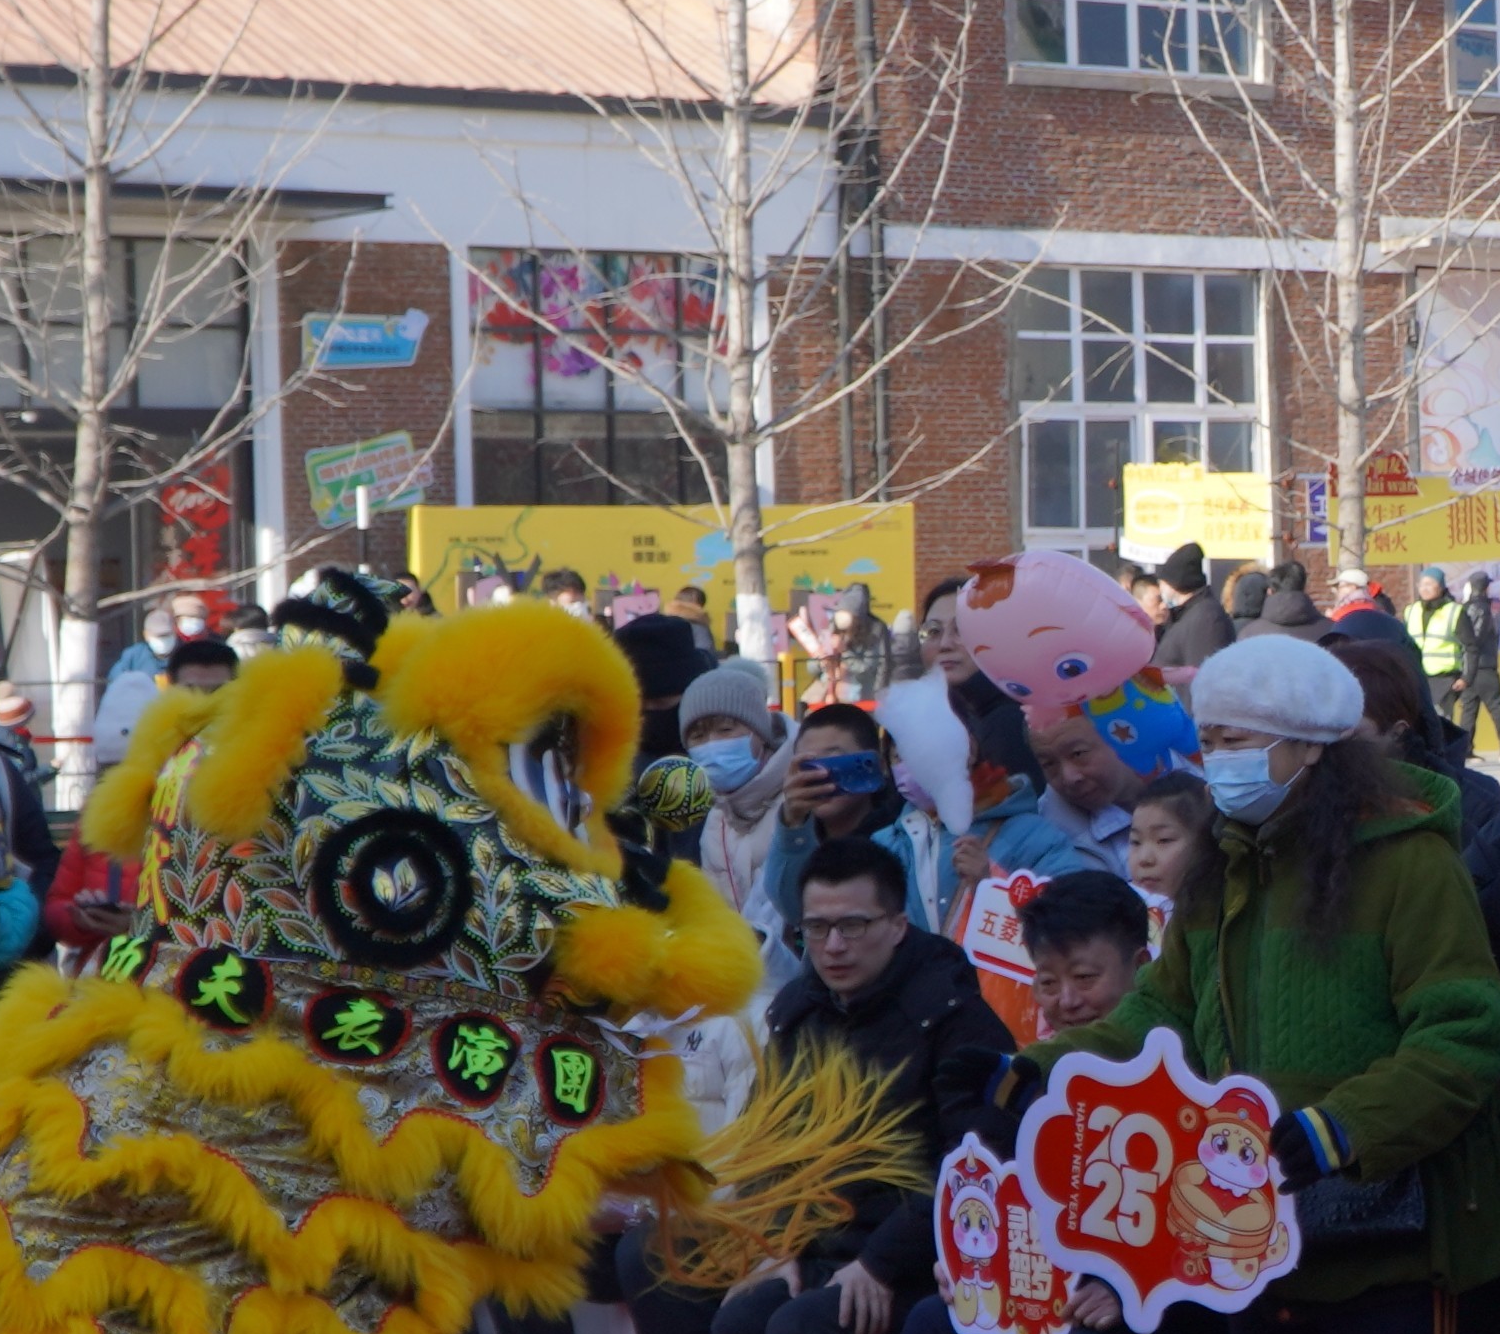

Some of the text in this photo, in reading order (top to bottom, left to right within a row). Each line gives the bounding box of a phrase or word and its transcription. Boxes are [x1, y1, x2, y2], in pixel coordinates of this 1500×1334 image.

[977, 909, 1029, 947] 五菱
[1066, 1101, 1086, 1232] HAPPY NEW YEAR
